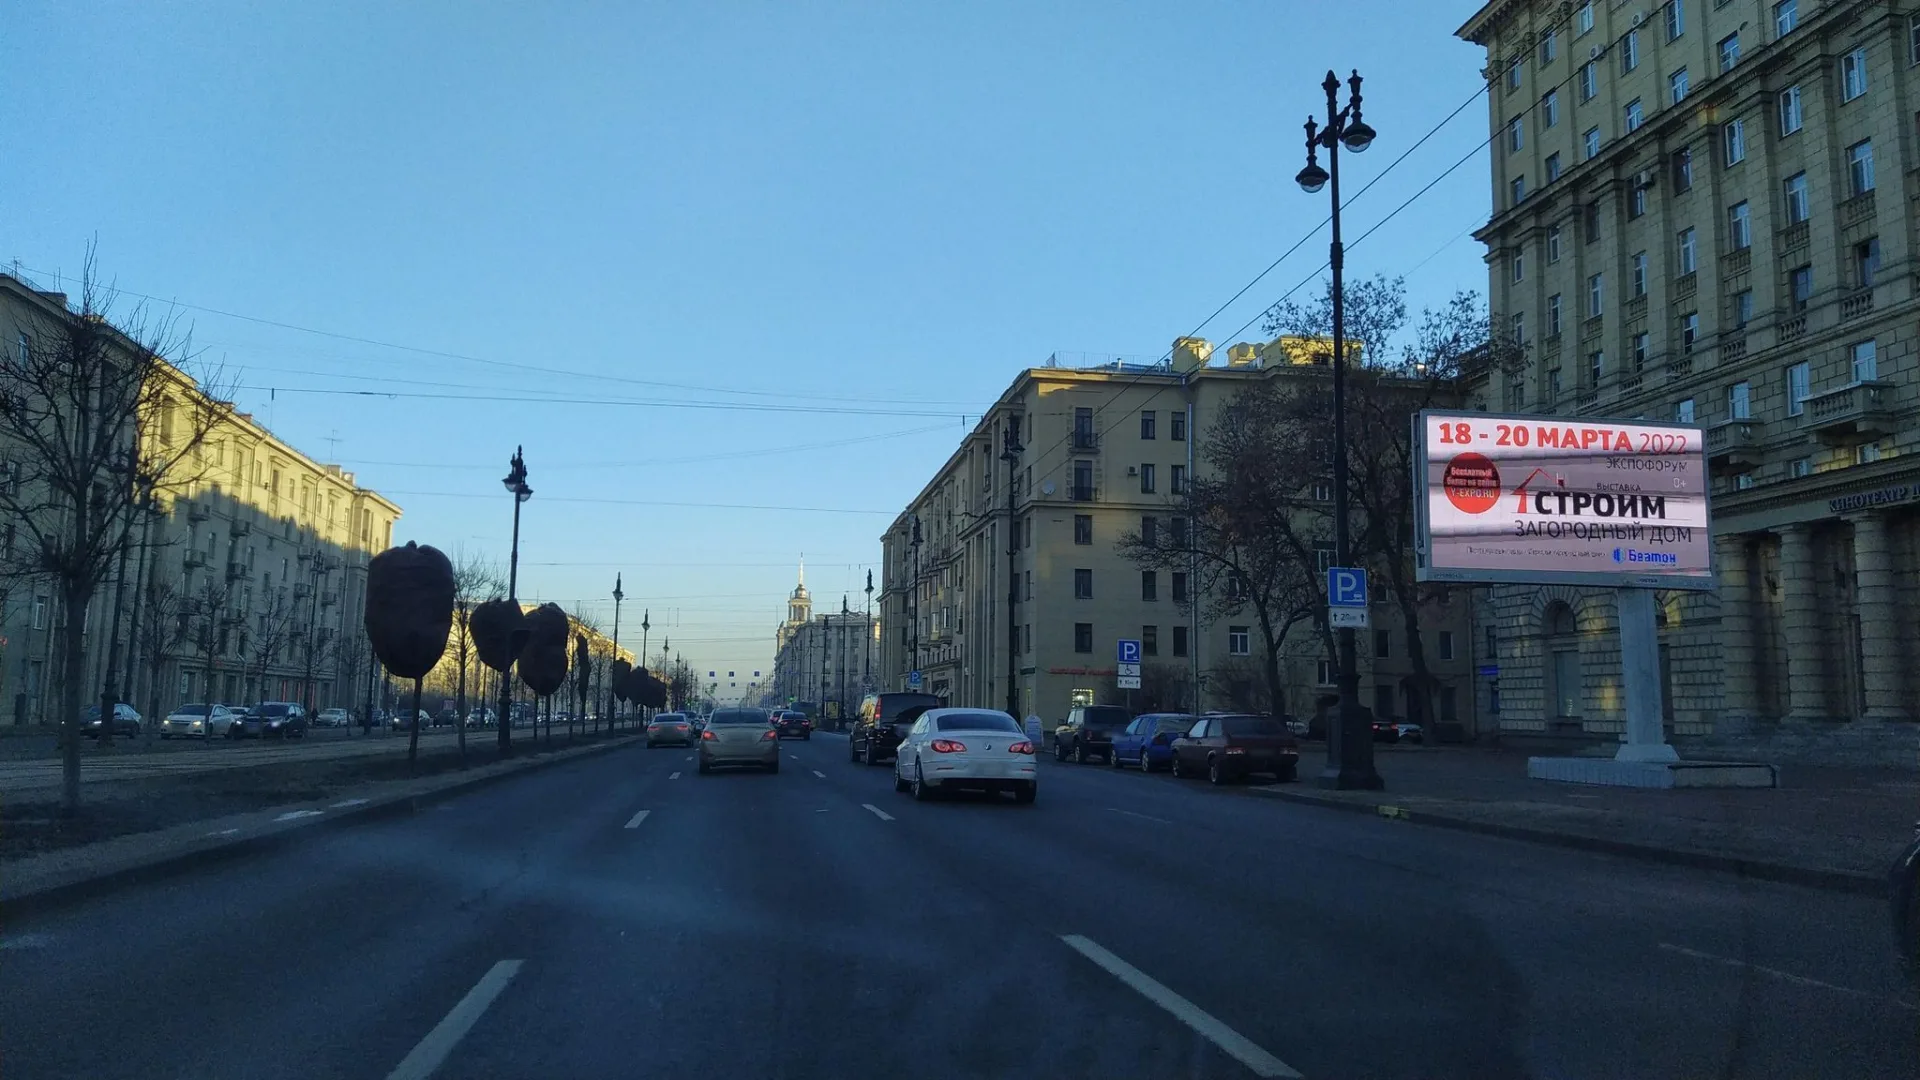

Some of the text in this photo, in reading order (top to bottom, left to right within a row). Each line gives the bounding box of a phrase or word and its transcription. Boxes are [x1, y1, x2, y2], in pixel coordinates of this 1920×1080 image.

[1439, 423, 1472, 444] 18
[1496, 425, 1530, 447] 20
[1537, 427, 1633, 452] МАРТА
[1639, 433, 1687, 455] 2022
[1606, 457, 1687, 472] ЭКСПОФОРУМ
[1596, 483, 1642, 491] ВЫСТАВКА
[1673, 478, 1687, 488] 0+
[1535, 491, 1666, 519] СТРОИМ
[1514, 520, 1692, 545] ЗАГОРОДНЫЙ ДОМ
[1628, 549, 1676, 562] Беатон
[1337, 573, 1357, 601] P
[1124, 642, 1137, 660] P
